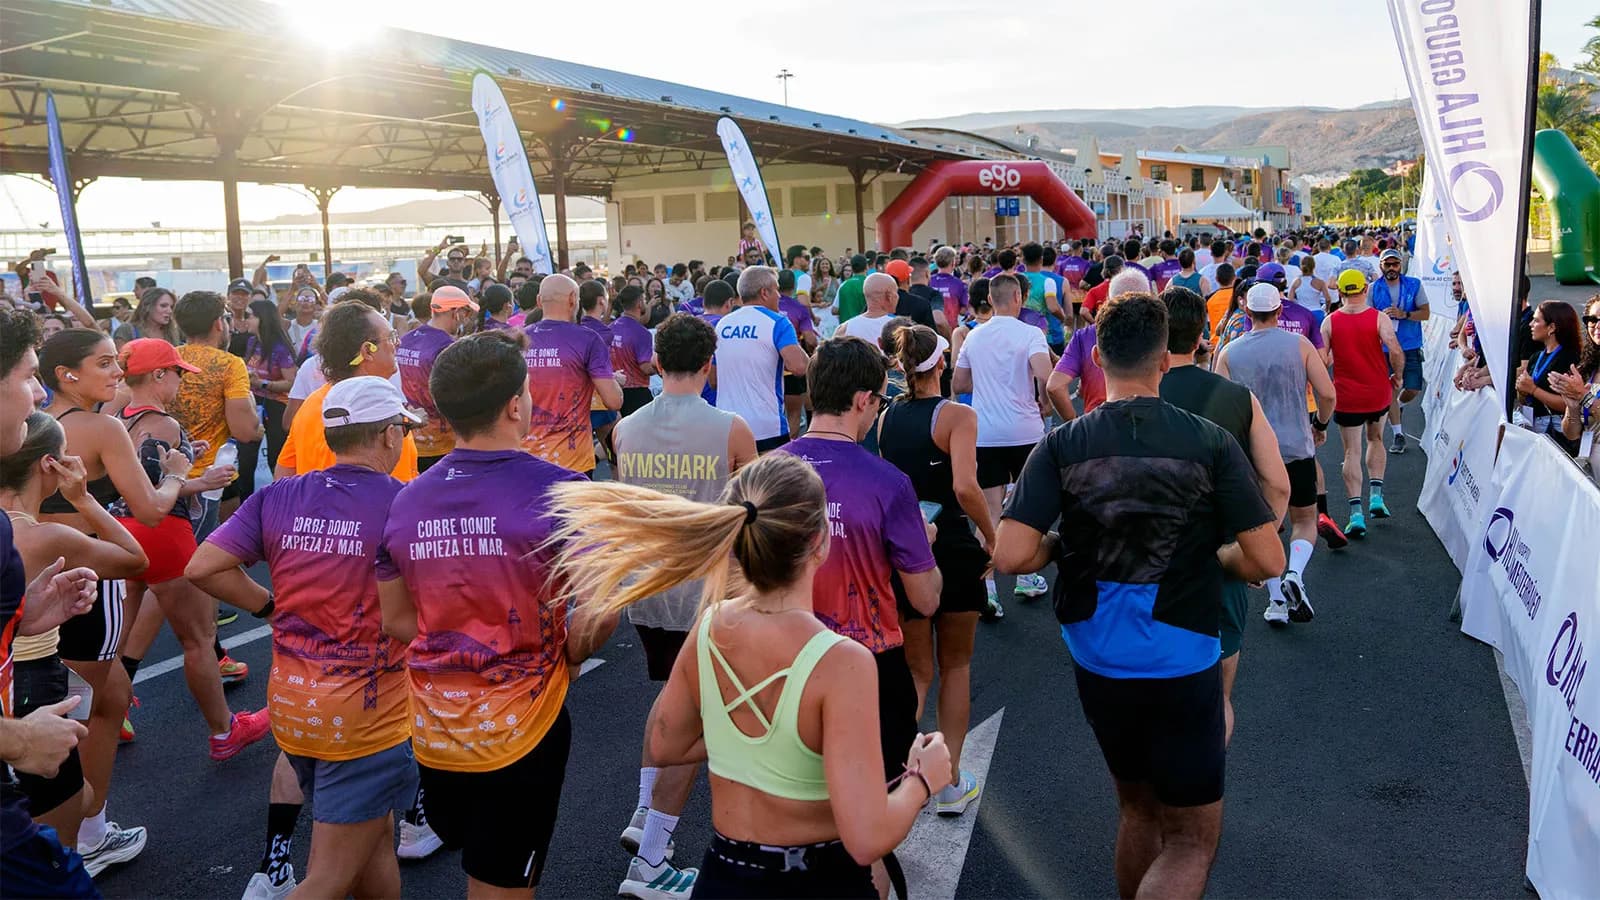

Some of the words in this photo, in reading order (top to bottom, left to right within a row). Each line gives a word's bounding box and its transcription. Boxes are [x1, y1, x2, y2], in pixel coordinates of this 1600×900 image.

[978, 164, 1021, 192] ego
[721, 325, 759, 340] CARL
[620, 452, 720, 481] GYMSHARK
[827, 502, 842, 519] NDE
[293, 516, 327, 535] CORRE
[327, 519, 362, 538] DONDE
[417, 518, 457, 539] CORRE
[460, 516, 497, 536] DONDE
[281, 534, 322, 553] EMPIEZA
[323, 537, 334, 554] EL
[337, 538, 367, 557] MAR.
[409, 540, 460, 562] EMPIEZA
[463, 538, 475, 556] EL
[478, 537, 508, 557] MAR.
